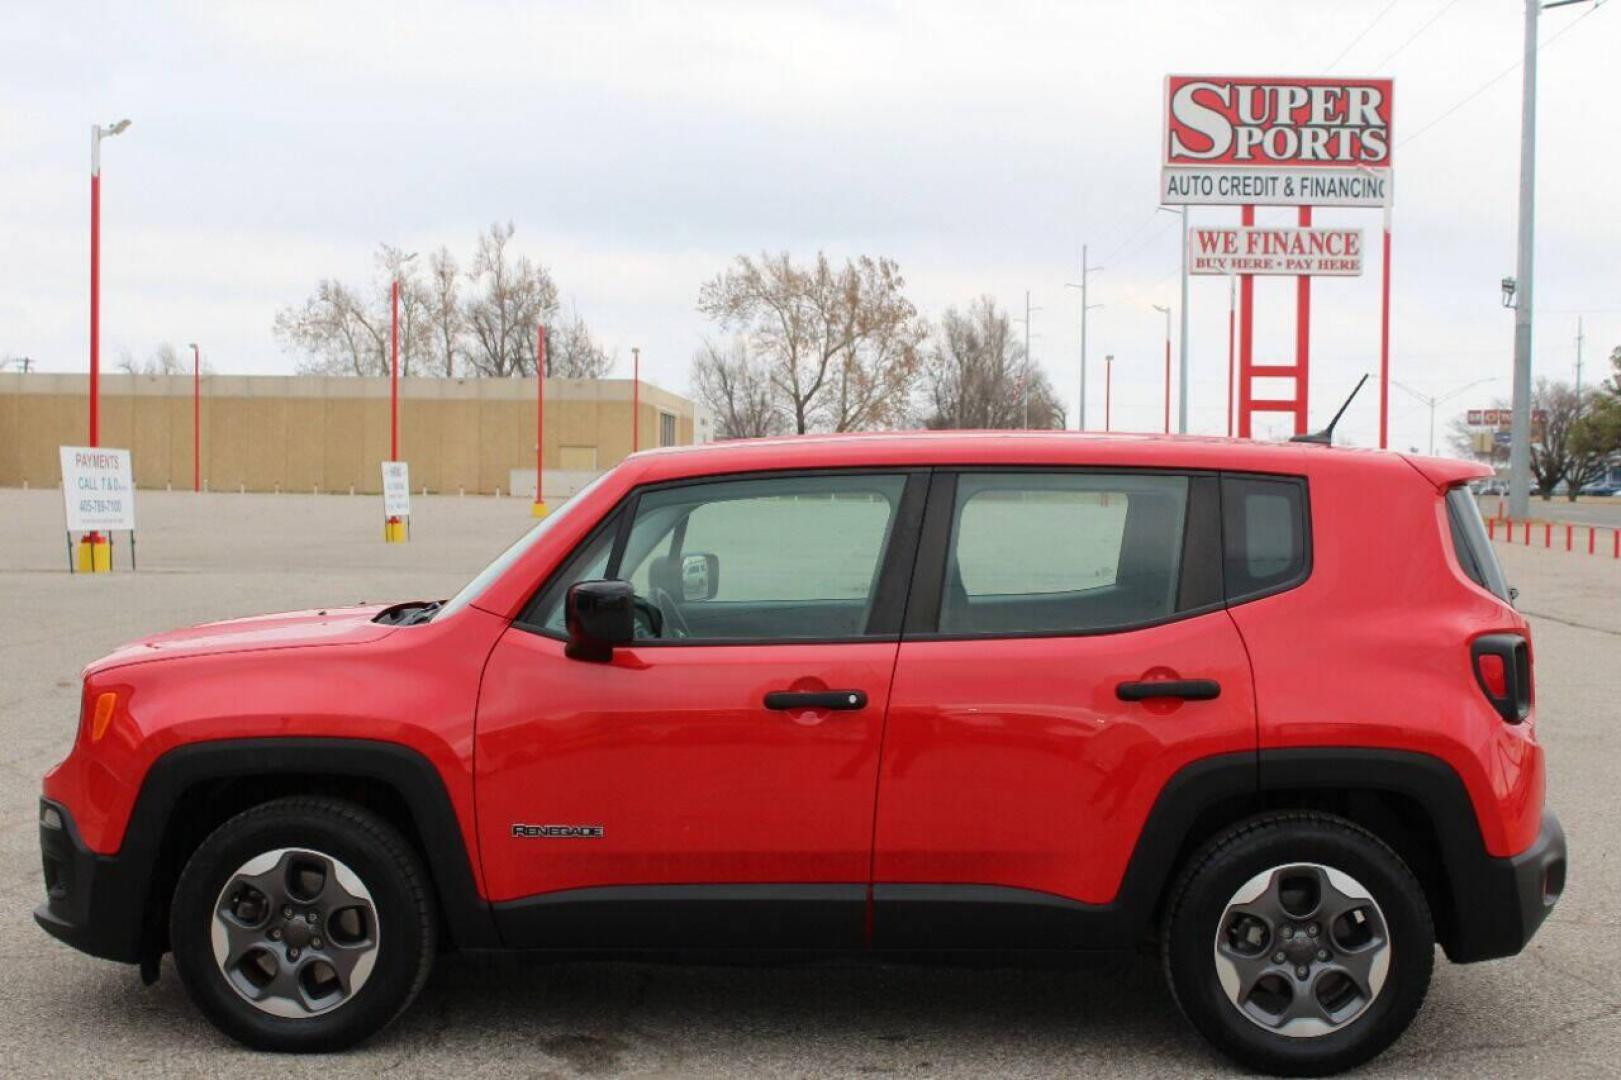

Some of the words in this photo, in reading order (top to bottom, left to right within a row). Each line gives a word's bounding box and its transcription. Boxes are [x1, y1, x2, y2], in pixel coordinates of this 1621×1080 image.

[1167, 175, 1213, 196] AUTO
[1218, 175, 1279, 197] CREDIT
[1283, 178, 1295, 197] &
[1197, 231, 1238, 255] WE
[1245, 231, 1360, 256] FINANCE
[1196, 257, 1228, 269] BUY
[1232, 257, 1274, 270] HERE
[1286, 258, 1314, 270] PAY
[1318, 258, 1360, 271] HERE
[75, 453, 120, 470] PAYMENTS
[78, 476, 98, 490] CALL
[512, 823, 604, 838] RENEGADE
